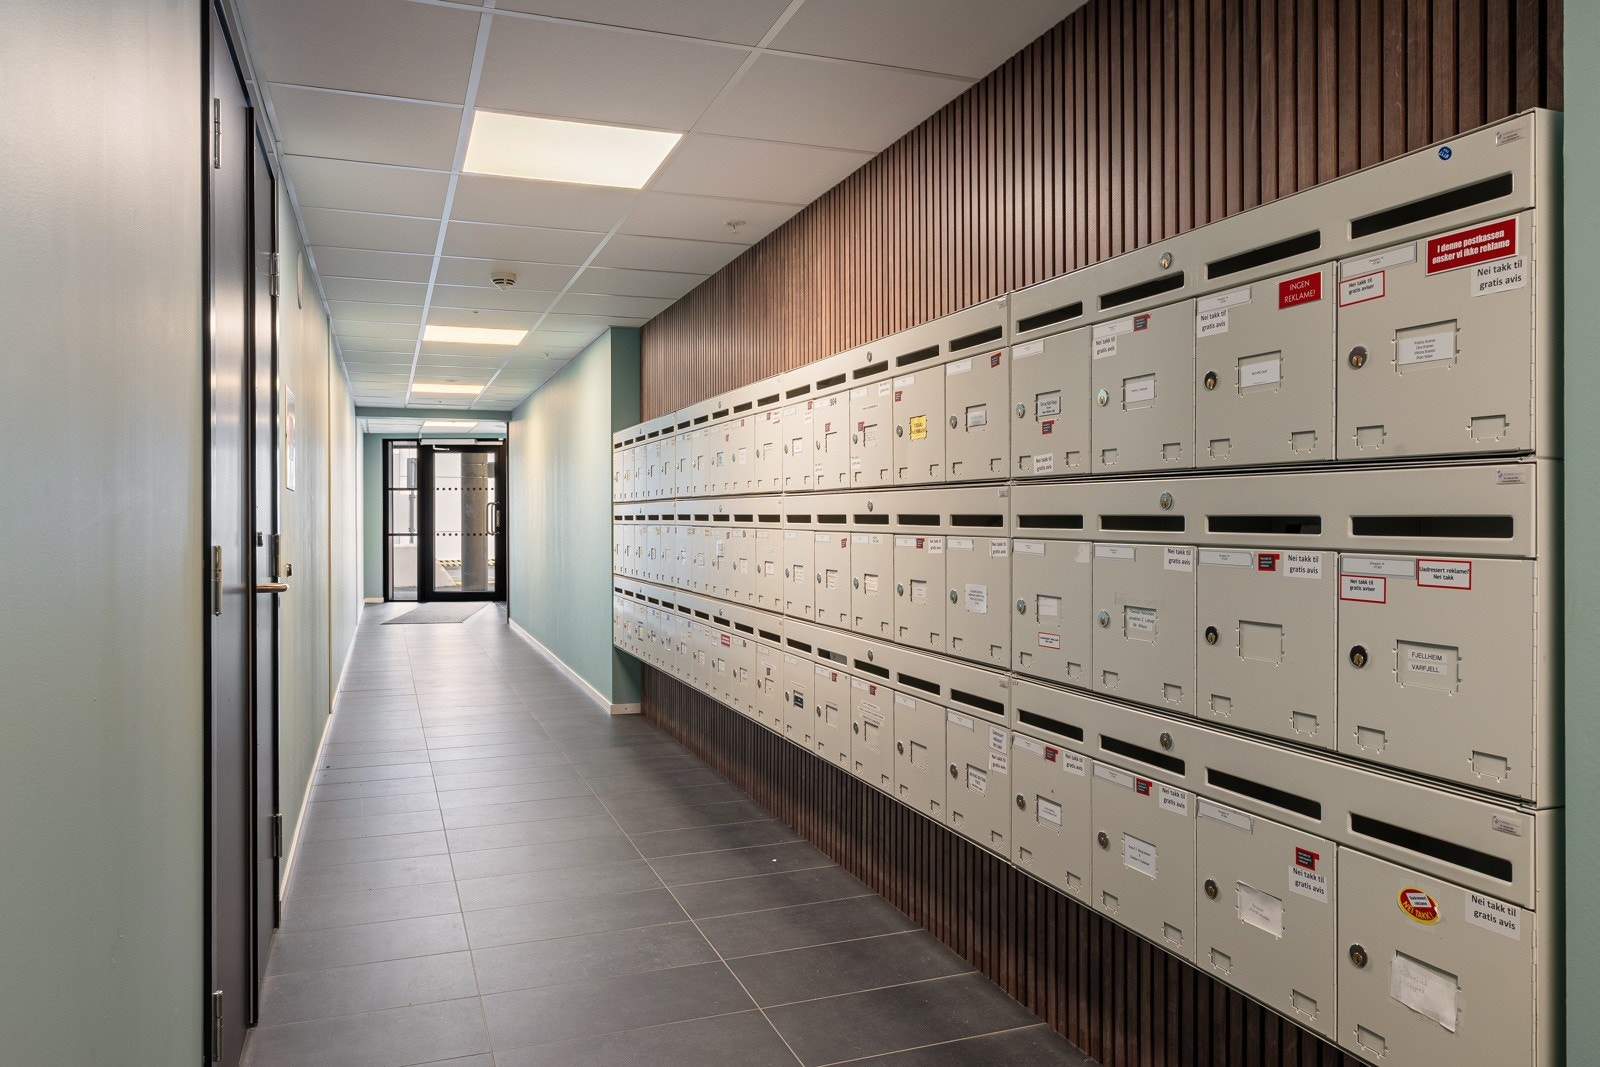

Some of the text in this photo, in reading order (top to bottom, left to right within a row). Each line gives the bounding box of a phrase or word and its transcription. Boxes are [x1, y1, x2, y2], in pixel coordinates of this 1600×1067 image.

[1441, 240, 1462, 252] denne
[1463, 230, 1505, 247] postkassen
[1456, 250, 1463, 259] vi
[1463, 247, 1479, 257] ikke
[1479, 239, 1510, 253] reklame
[1477, 259, 1523, 276] Nei takk til
[1290, 280, 1310, 291] INGEN
[1479, 274, 1522, 291] gratis avis
[1284, 289, 1316, 303] REKLAME!
[1348, 287, 1361, 296] gratis
[1210, 311, 1220, 319] takk
[1202, 320, 1226, 332] gratis avis
[1298, 555, 1312, 563] takk
[1289, 566, 1319, 574] gratis avis
[1411, 651, 1443, 661] FJELLHEIM
[1411, 664, 1440, 673] VARFJELL
[1292, 867, 1303, 876] Nei
[1304, 871, 1317, 881] takk
[1294, 880, 1325, 895] gratis avis
[1402, 901, 1434, 919] NEI TAKK!
[1471, 894, 1516, 917] Nei takk til
[1473, 910, 1516, 930] gratis avis
